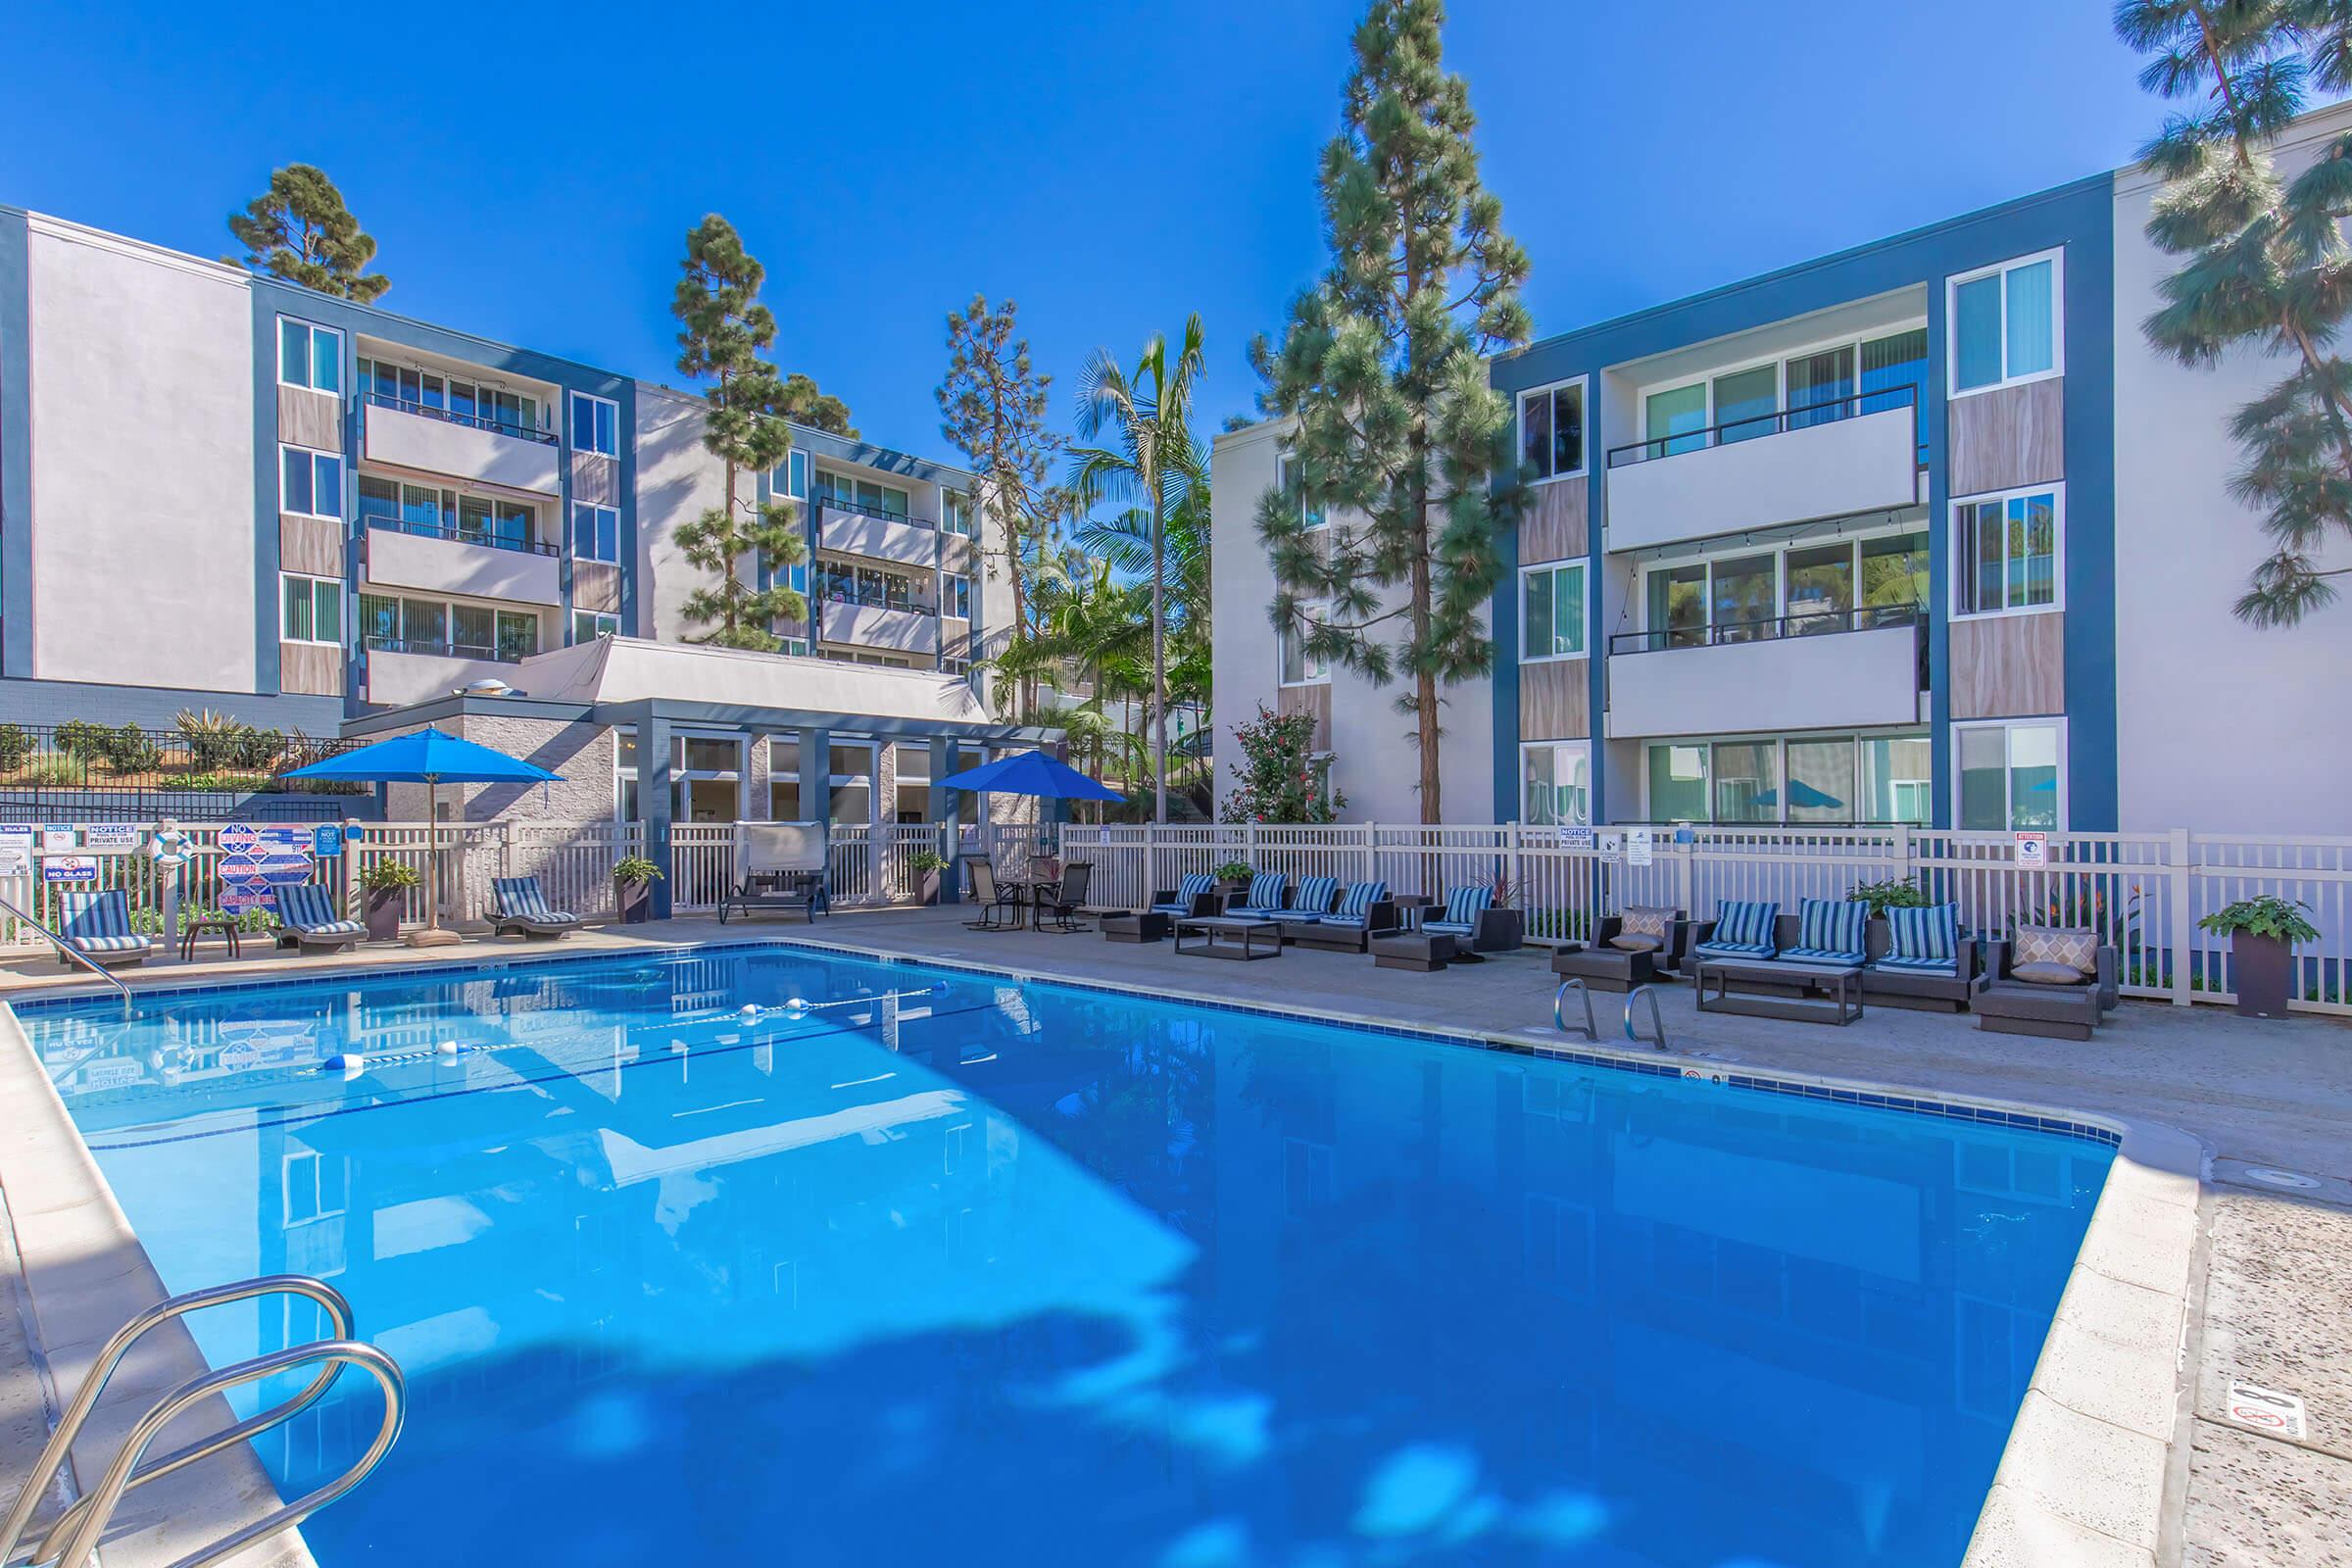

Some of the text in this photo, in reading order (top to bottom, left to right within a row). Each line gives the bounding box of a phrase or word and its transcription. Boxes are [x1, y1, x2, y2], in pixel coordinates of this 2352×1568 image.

[231, 824, 246, 833] NO
[220, 833, 256, 842] DIVING
[220, 864, 255, 874] CAUTION
[220, 895, 256, 905] CAPACITY
